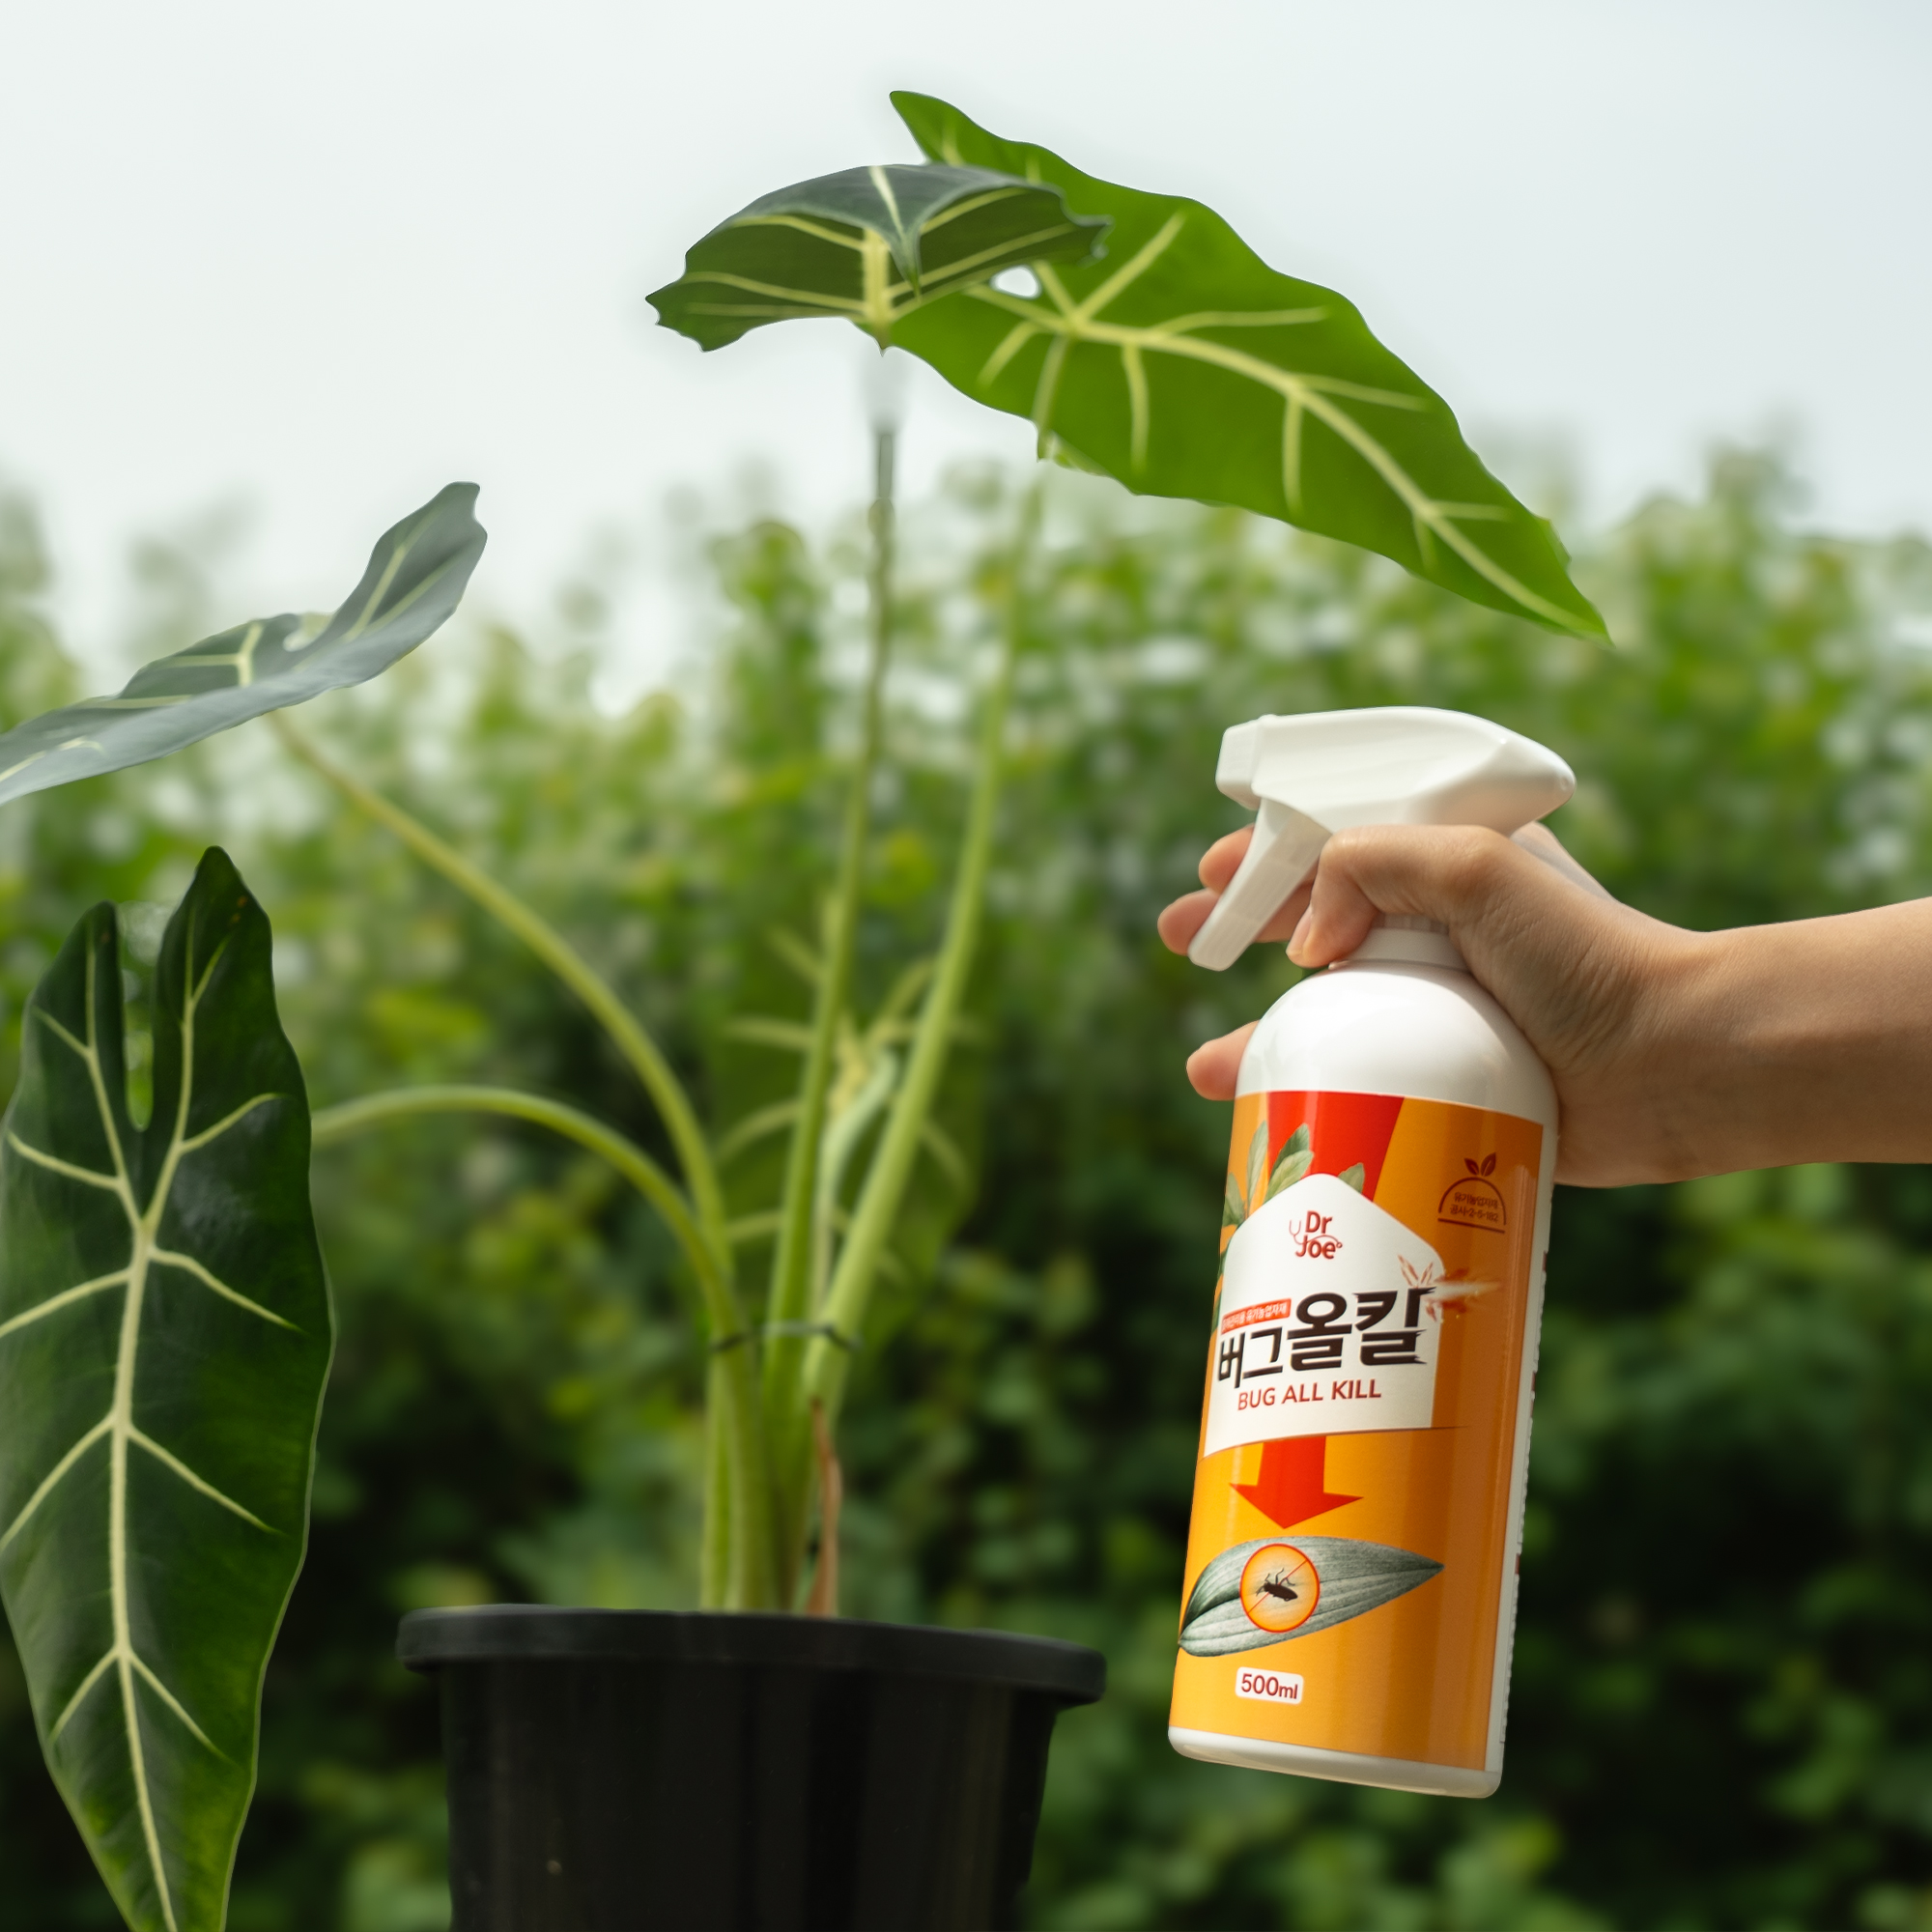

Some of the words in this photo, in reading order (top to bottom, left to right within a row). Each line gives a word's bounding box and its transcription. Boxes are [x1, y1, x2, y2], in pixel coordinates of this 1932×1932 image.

[1305, 1210, 1333, 1234] Dr
[1294, 1235, 1336, 1260] Joe
[1217, 1286, 1436, 1389] 버그올킬
[1237, 1387, 1276, 1411] BUG
[1281, 1382, 1323, 1405] ALL
[1331, 1378, 1382, 1401] KILL
[1241, 1672, 1298, 1700] 500ml
